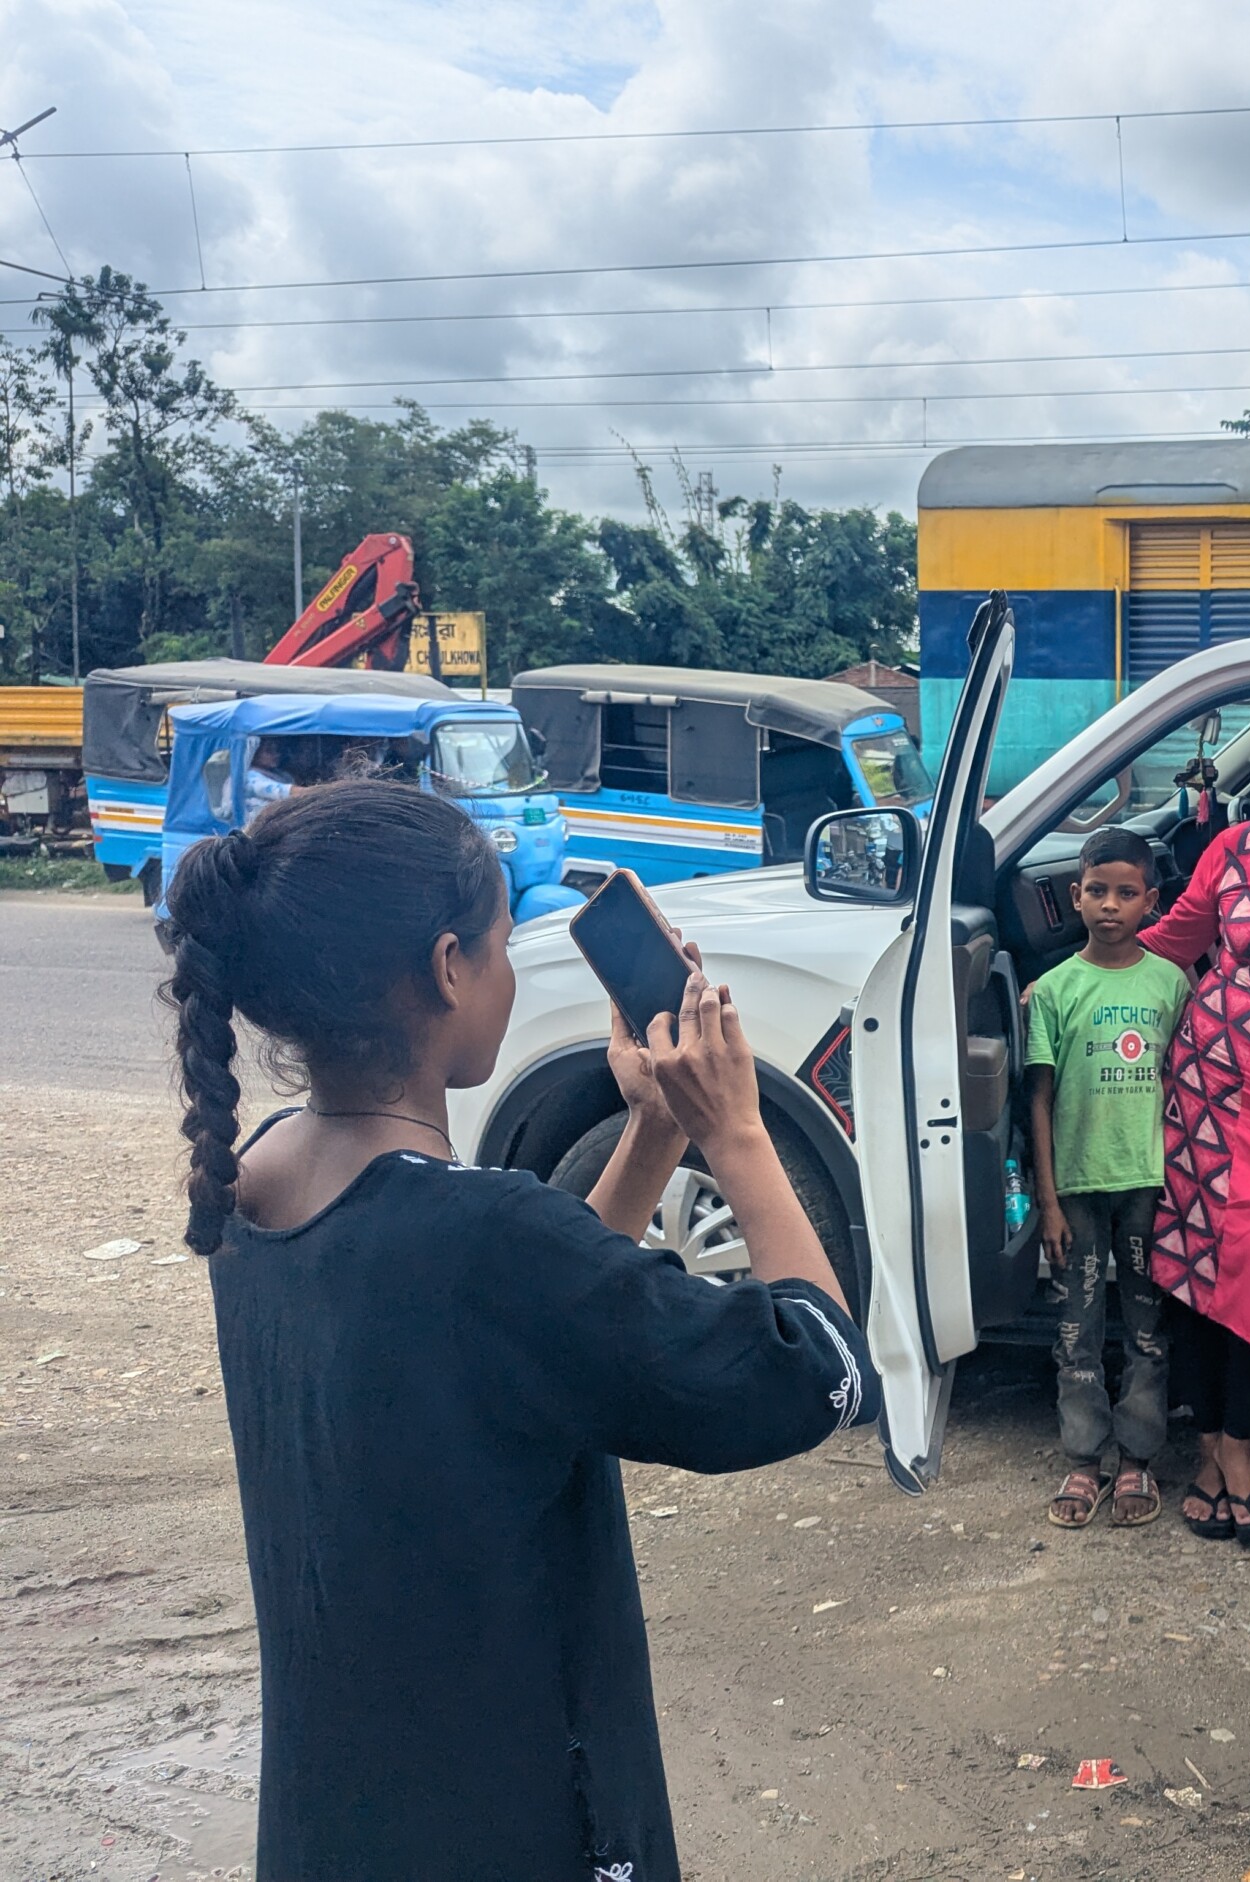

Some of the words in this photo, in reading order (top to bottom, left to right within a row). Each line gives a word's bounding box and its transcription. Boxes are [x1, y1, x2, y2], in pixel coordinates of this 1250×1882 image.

[319, 568, 355, 609] PALFINGER
[1093, 1006, 1138, 1025] WATCH
[1107, 1086, 1123, 1094] NEW
[1126, 1086, 1143, 1094] YORK
